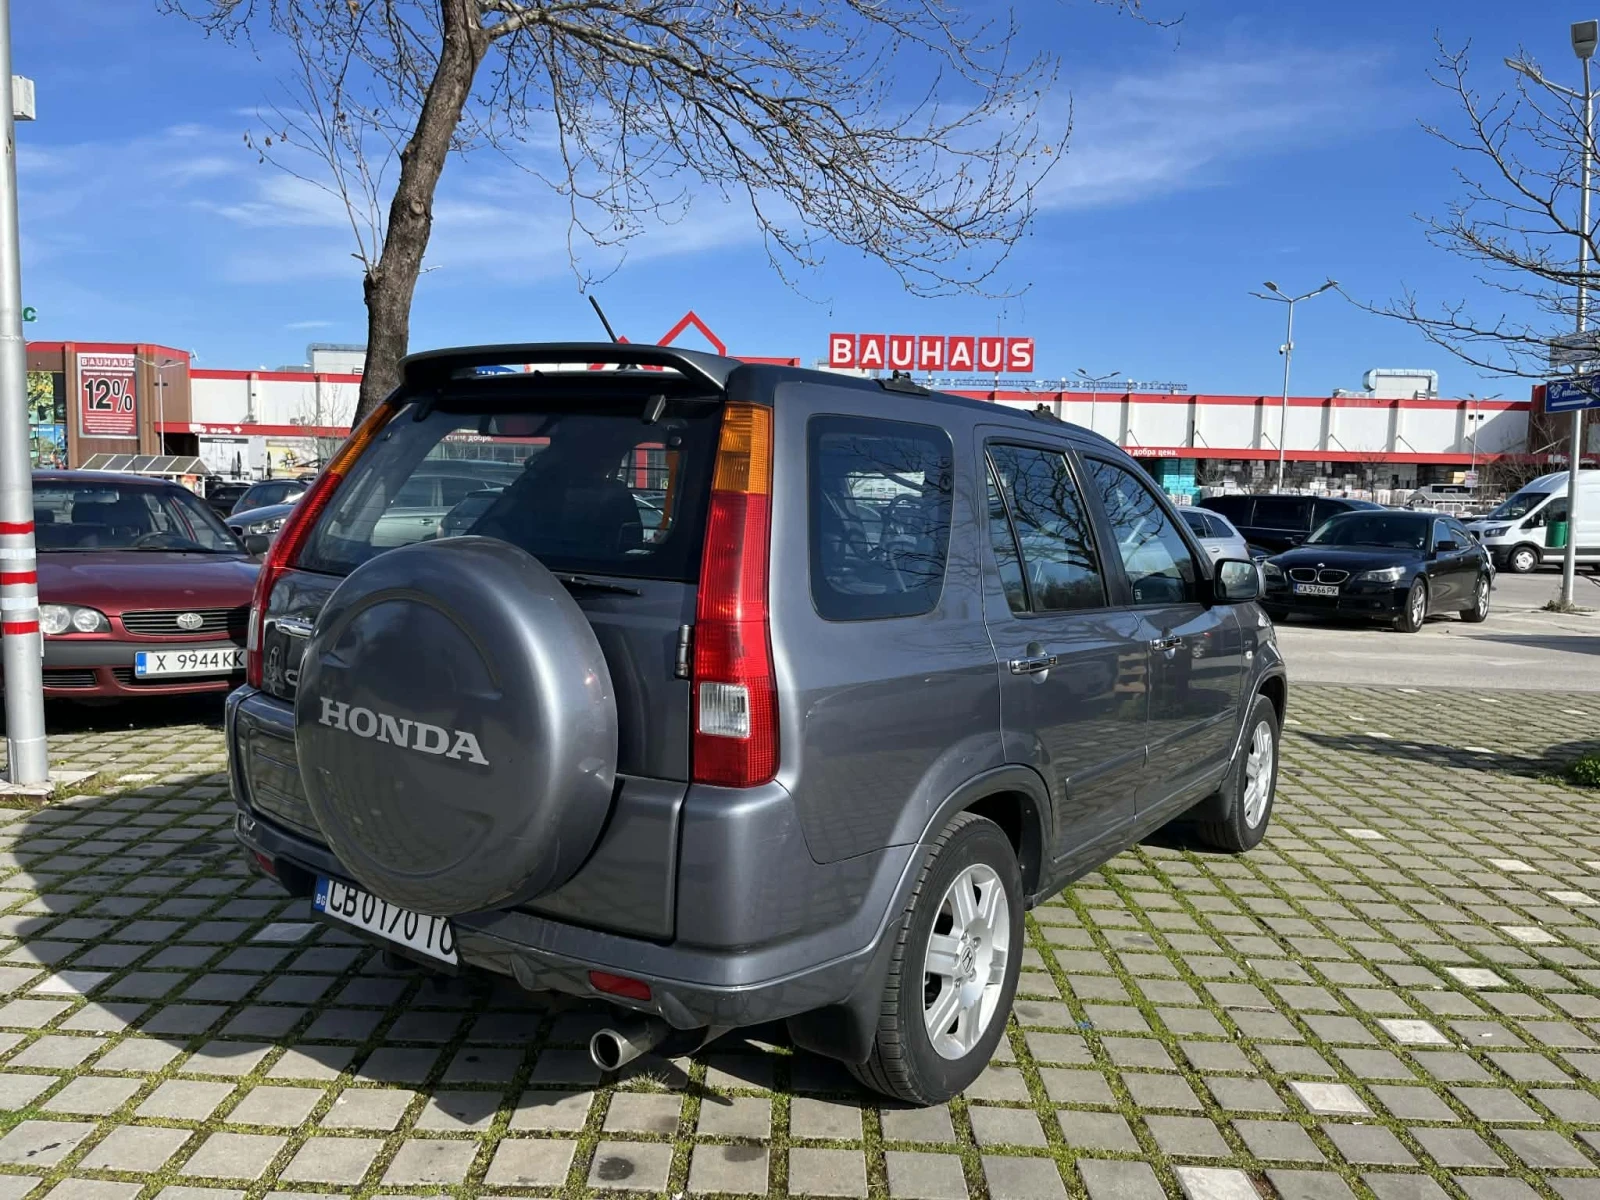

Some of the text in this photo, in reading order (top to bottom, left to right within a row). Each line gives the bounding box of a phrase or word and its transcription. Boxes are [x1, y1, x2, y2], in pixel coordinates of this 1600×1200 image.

[81, 357, 135, 367] BAUHAUS
[832, 338, 1032, 368] BAUHAUS
[84, 378, 134, 413] 12%
[1133, 448, 1156, 457] добра
[318, 696, 489, 765] HONDA
